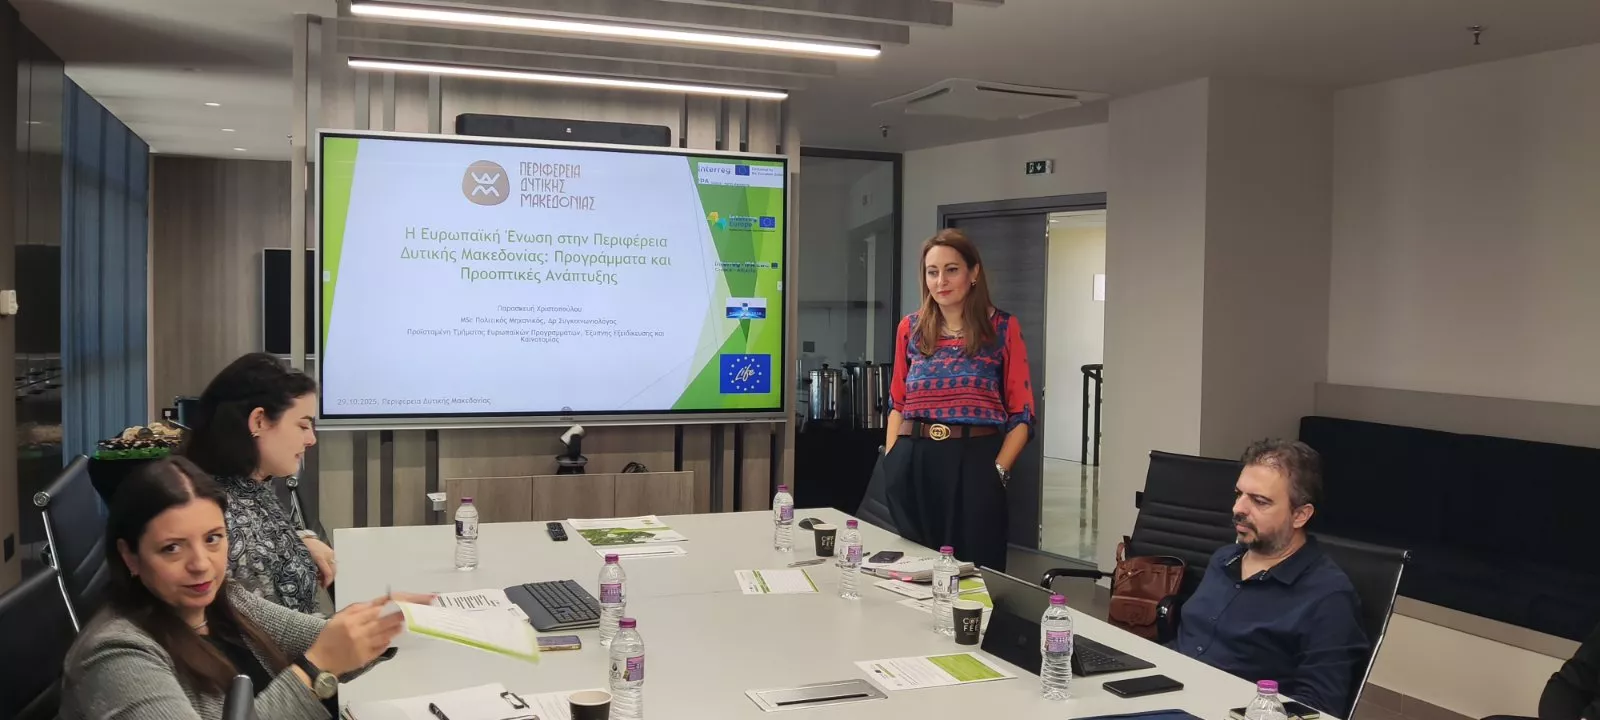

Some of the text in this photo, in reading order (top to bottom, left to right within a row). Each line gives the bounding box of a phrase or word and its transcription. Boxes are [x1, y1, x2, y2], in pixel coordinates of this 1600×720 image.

[519, 161, 581, 178] ΠΕΡΙΦΕΡΕΙΑ
[520, 178, 566, 194] ΔΥΤΙΚΗΣ
[520, 194, 596, 210] ΜΑΚΕΔΟΝΙΑΣ
[421, 227, 501, 243] Ευρωπαϊκή
[505, 230, 553, 245] Ένωση
[557, 234, 589, 246] στην
[593, 233, 668, 249] Περιφέρεια
[400, 247, 672, 267] Δυτικής Μακεδονίας: Προγράμματα και
[460, 267, 618, 285] Προοπτικές Ανάπτυξης
[497, 305, 582, 313] Παρασκευή Χριστοπούλου
[735, 363, 755, 382] Life
